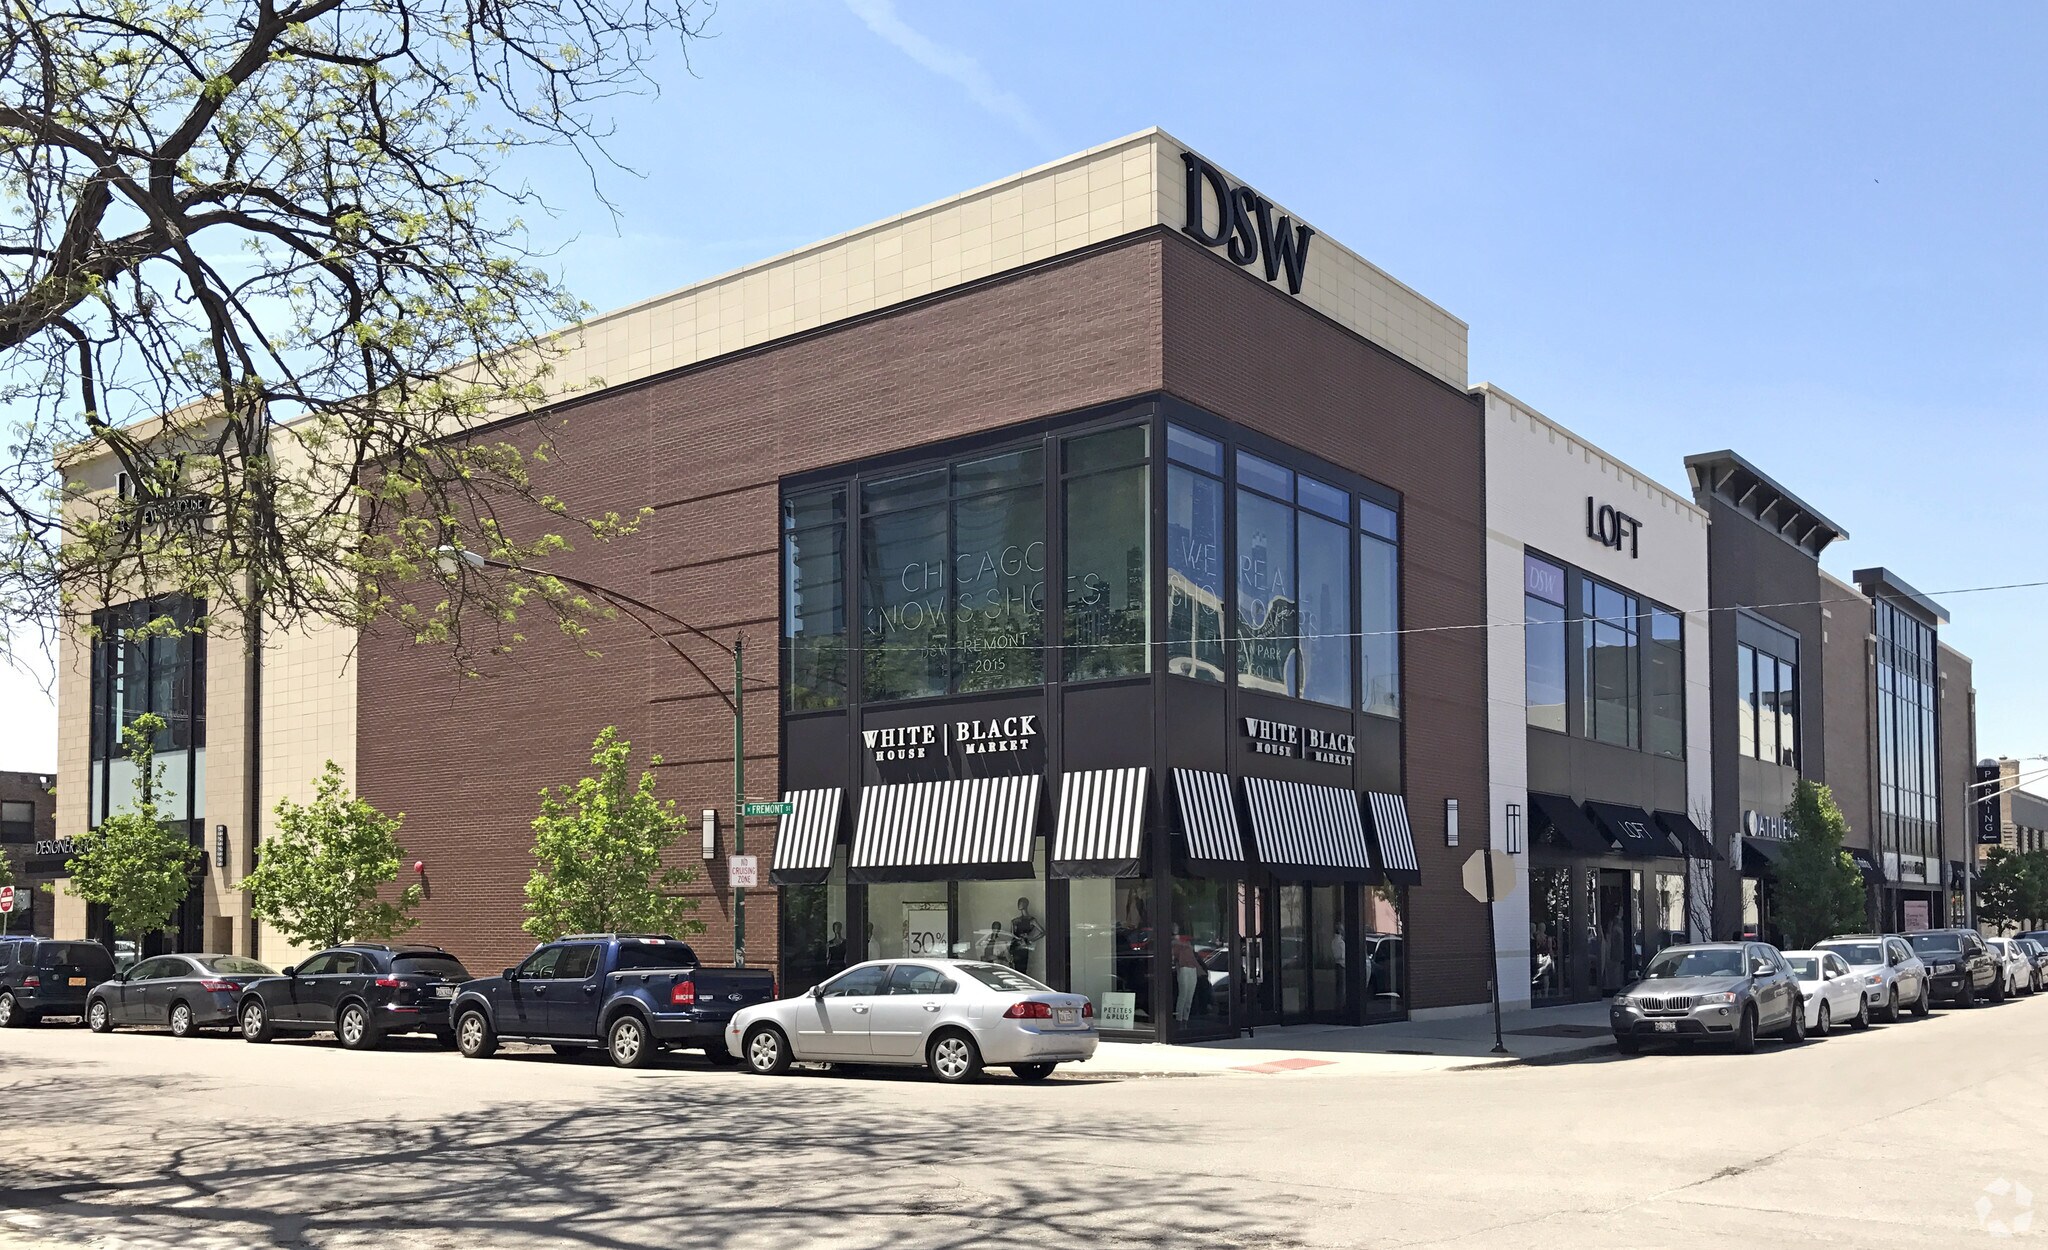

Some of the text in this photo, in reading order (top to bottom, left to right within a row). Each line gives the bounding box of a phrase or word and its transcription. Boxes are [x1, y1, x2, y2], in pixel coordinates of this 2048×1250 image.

[1180, 151, 1315, 295] DSW
[1586, 496, 1643, 559] LOFT
[901, 541, 1045, 592] CHCAGO
[1530, 567, 1557, 594] DSW
[1257, 644, 1282, 661] PARK
[862, 715, 1037, 749] WHITE BLACK
[1245, 717, 1356, 754] WHITE BLACK
[876, 739, 1029, 762] HOUSE MARKET
[1256, 742, 1352, 766] HOUSE MARKET
[752, 804, 783, 814] FREMONT
[1617, 820, 1653, 839] LOFT
[1758, 815, 1798, 839] ATHLE
[36, 839, 74, 854] DESIGNER
[732, 866, 756, 874] CRUISING
[741, 858, 748, 866] NO
[737, 875, 751, 883] ZONE
[911, 931, 947, 954] 30%
[1103, 1006, 1132, 1014] PETITES
